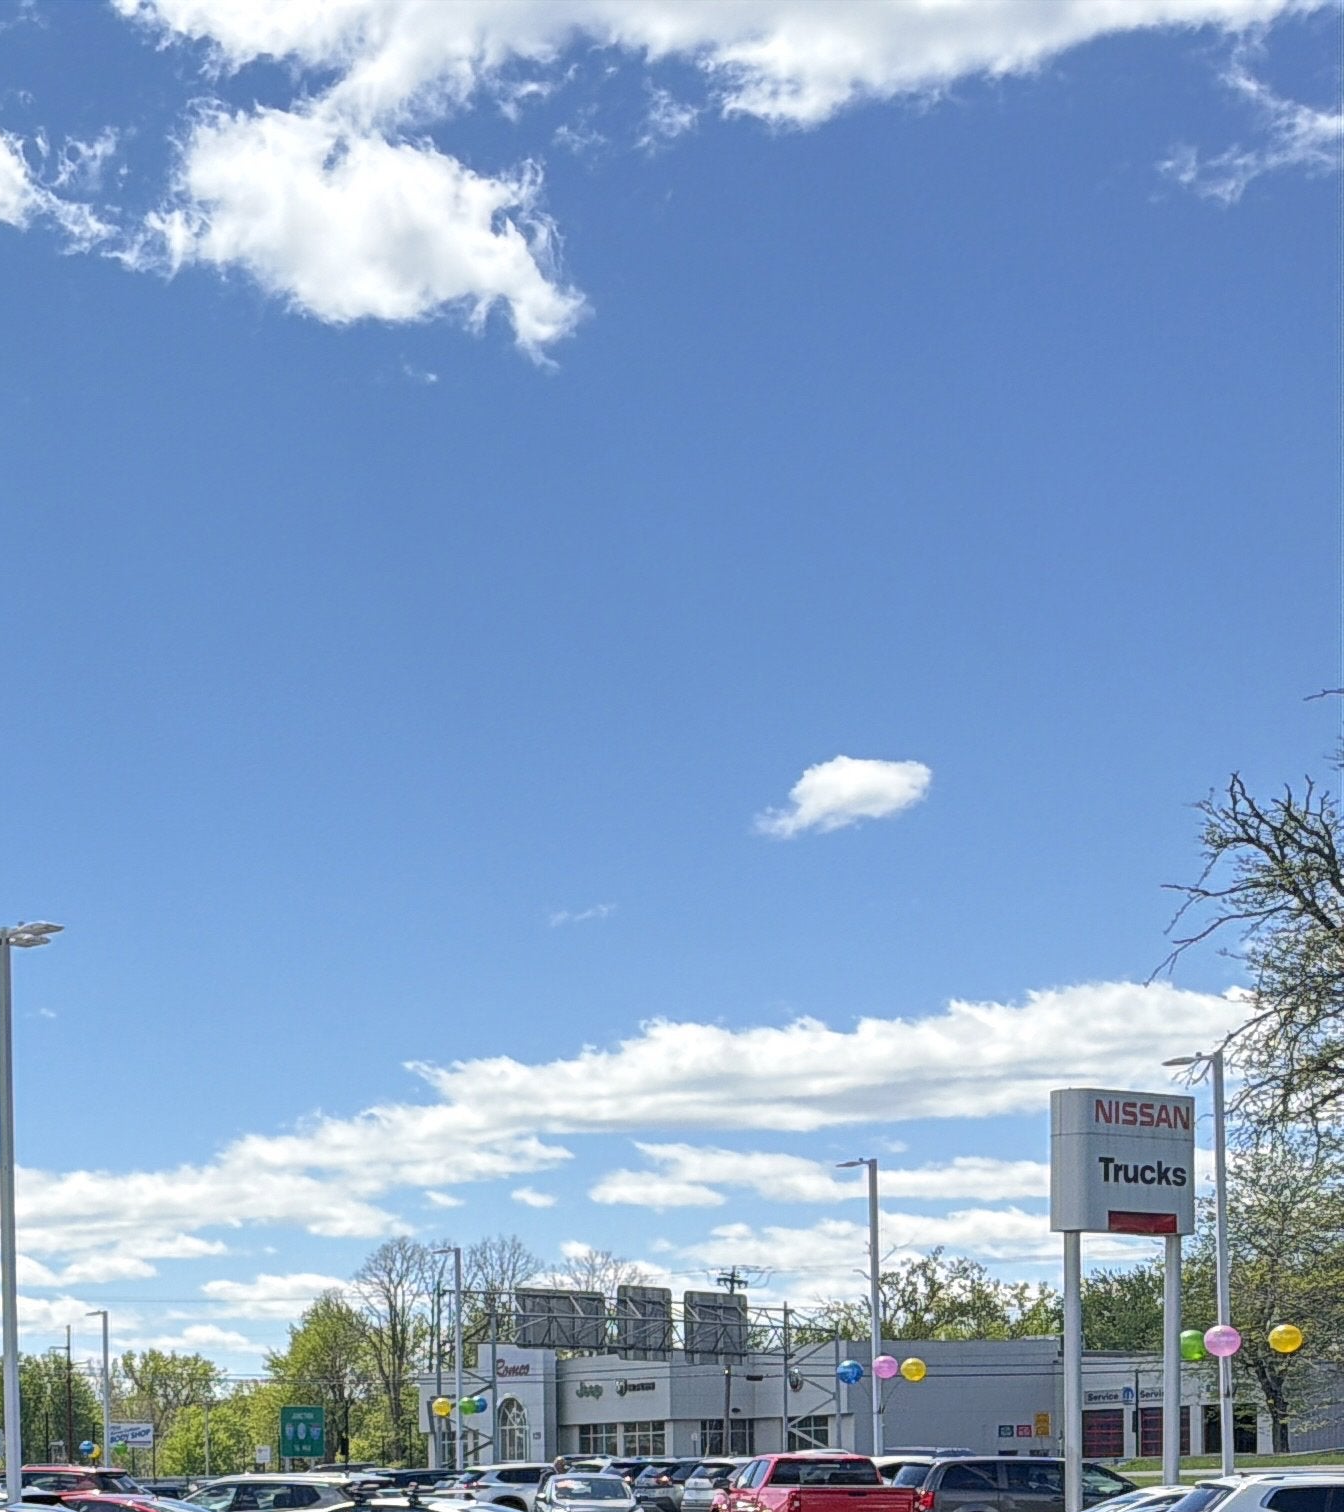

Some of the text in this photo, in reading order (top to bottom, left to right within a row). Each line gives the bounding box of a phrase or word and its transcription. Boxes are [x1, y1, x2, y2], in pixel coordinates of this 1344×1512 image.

[1095, 1099, 1190, 1130] NISSAN
[1098, 1157, 1187, 1187] Trucks
[496, 1358, 530, 1377] Romeo
[575, 1380, 603, 1400] Jeep
[1087, 1392, 1119, 1402] Service
[1140, 1389, 1164, 1399] Servi
